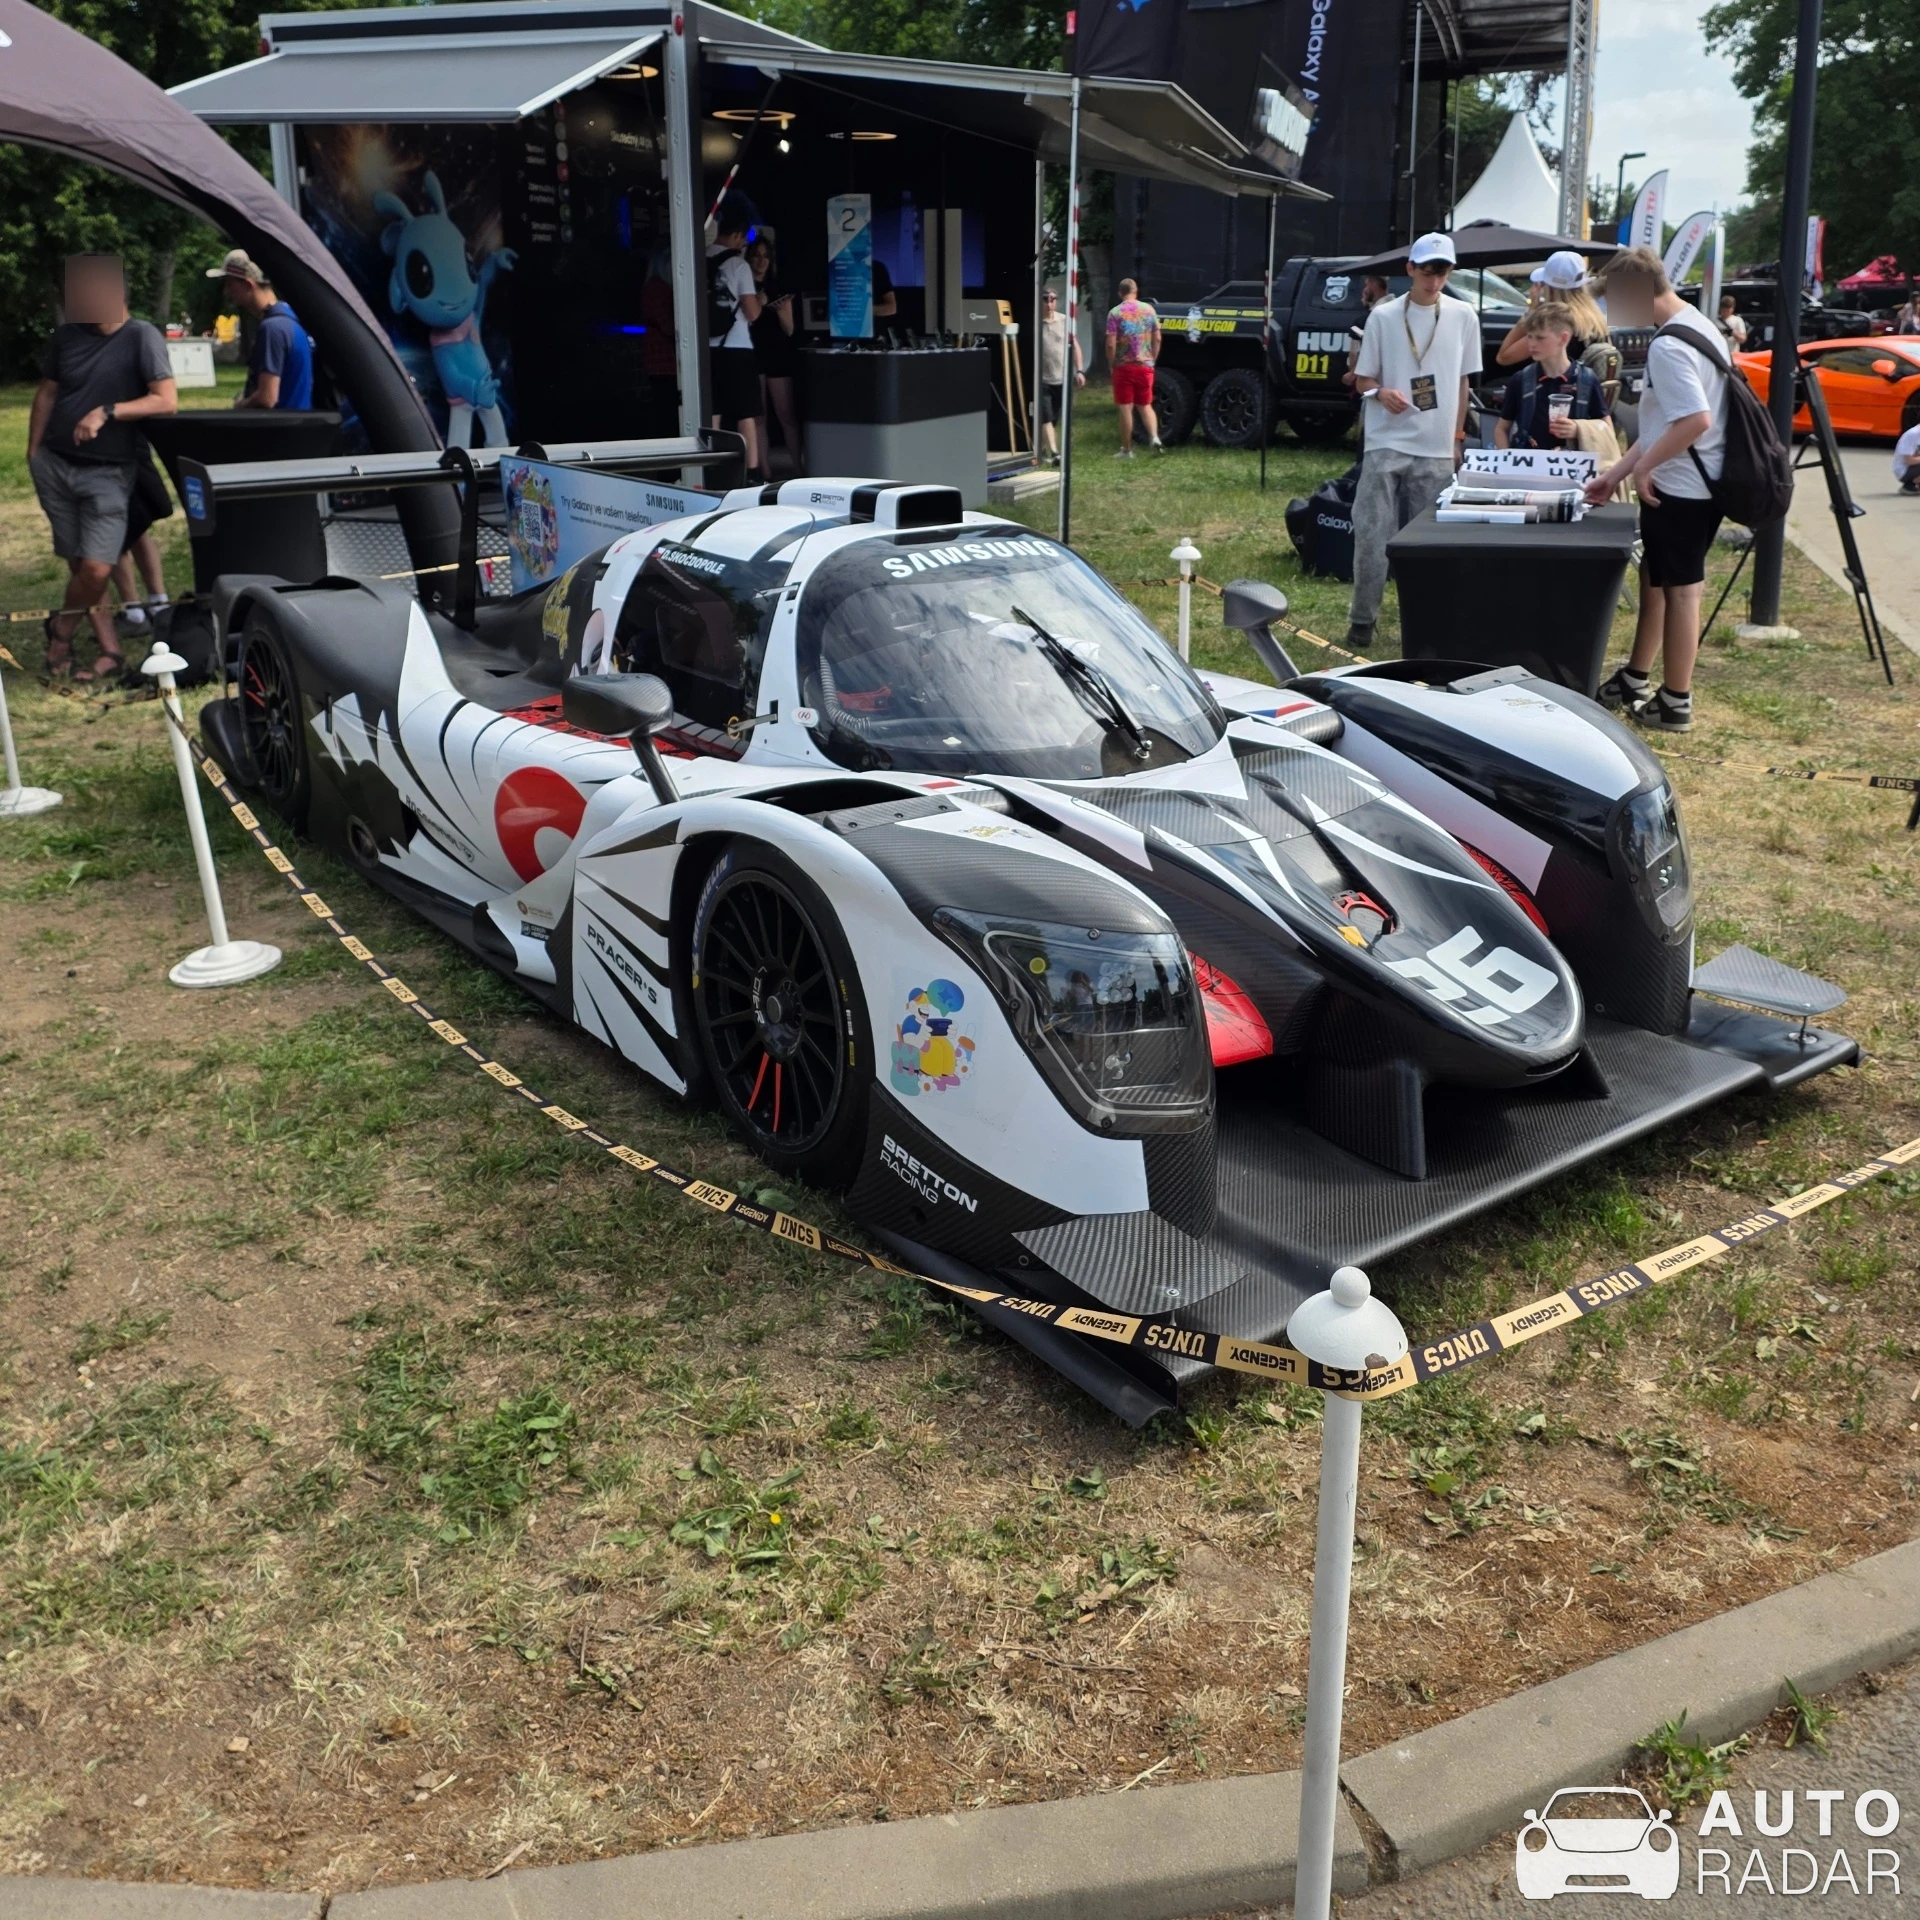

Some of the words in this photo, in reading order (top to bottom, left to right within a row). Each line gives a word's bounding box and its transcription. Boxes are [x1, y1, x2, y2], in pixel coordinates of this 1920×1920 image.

[1300, 0, 1331, 81] Galaxy
[842, 208, 856, 232] 2
[1162, 319, 1188, 330] ROAD
[1296, 354, 1329, 373] D11
[1415, 378, 1430, 388] VIP
[571, 498, 593, 515] Galaxy
[594, 504, 602, 514] ve
[603, 505, 624, 520] vašem
[646, 493, 684, 513] SAMSUNG
[1317, 513, 1355, 534] Galaxy
[661, 549, 727, 575] D.SKOČDOPOLE
[882, 540, 1060, 578] SAMSUNG
[1775, 768, 1810, 779] UNCS
[1876, 777, 1916, 790] UNCS
[692, 853, 729, 948] MICHELIN
[587, 923, 657, 1005] PRAGER'S
[345, 938, 368, 957] UNCS
[388, 981, 412, 999] UNCS
[434, 1023, 460, 1041] UNCS
[486, 1065, 515, 1083] UNCS
[549, 1109, 580, 1126] UNCS
[615, 1148, 650, 1167] UNCS
[692, 1184, 729, 1206] UNCS
[734, 1203, 769, 1223] LEGENDY
[779, 1216, 815, 1245] UNCS
[880, 1149, 939, 1204] RACING
[883, 1134, 978, 1213] BRETTON
[1836, 1163, 1889, 1185] UNCS
[1721, 1213, 1779, 1242] UNCS
[1578, 1271, 1643, 1307] UNCS
[998, 1297, 1057, 1319] UNCS
[1144, 1325, 1206, 1358] UNCS
[1423, 1329, 1490, 1373] UNCS
[1322, 1364, 1364, 1387] CS
